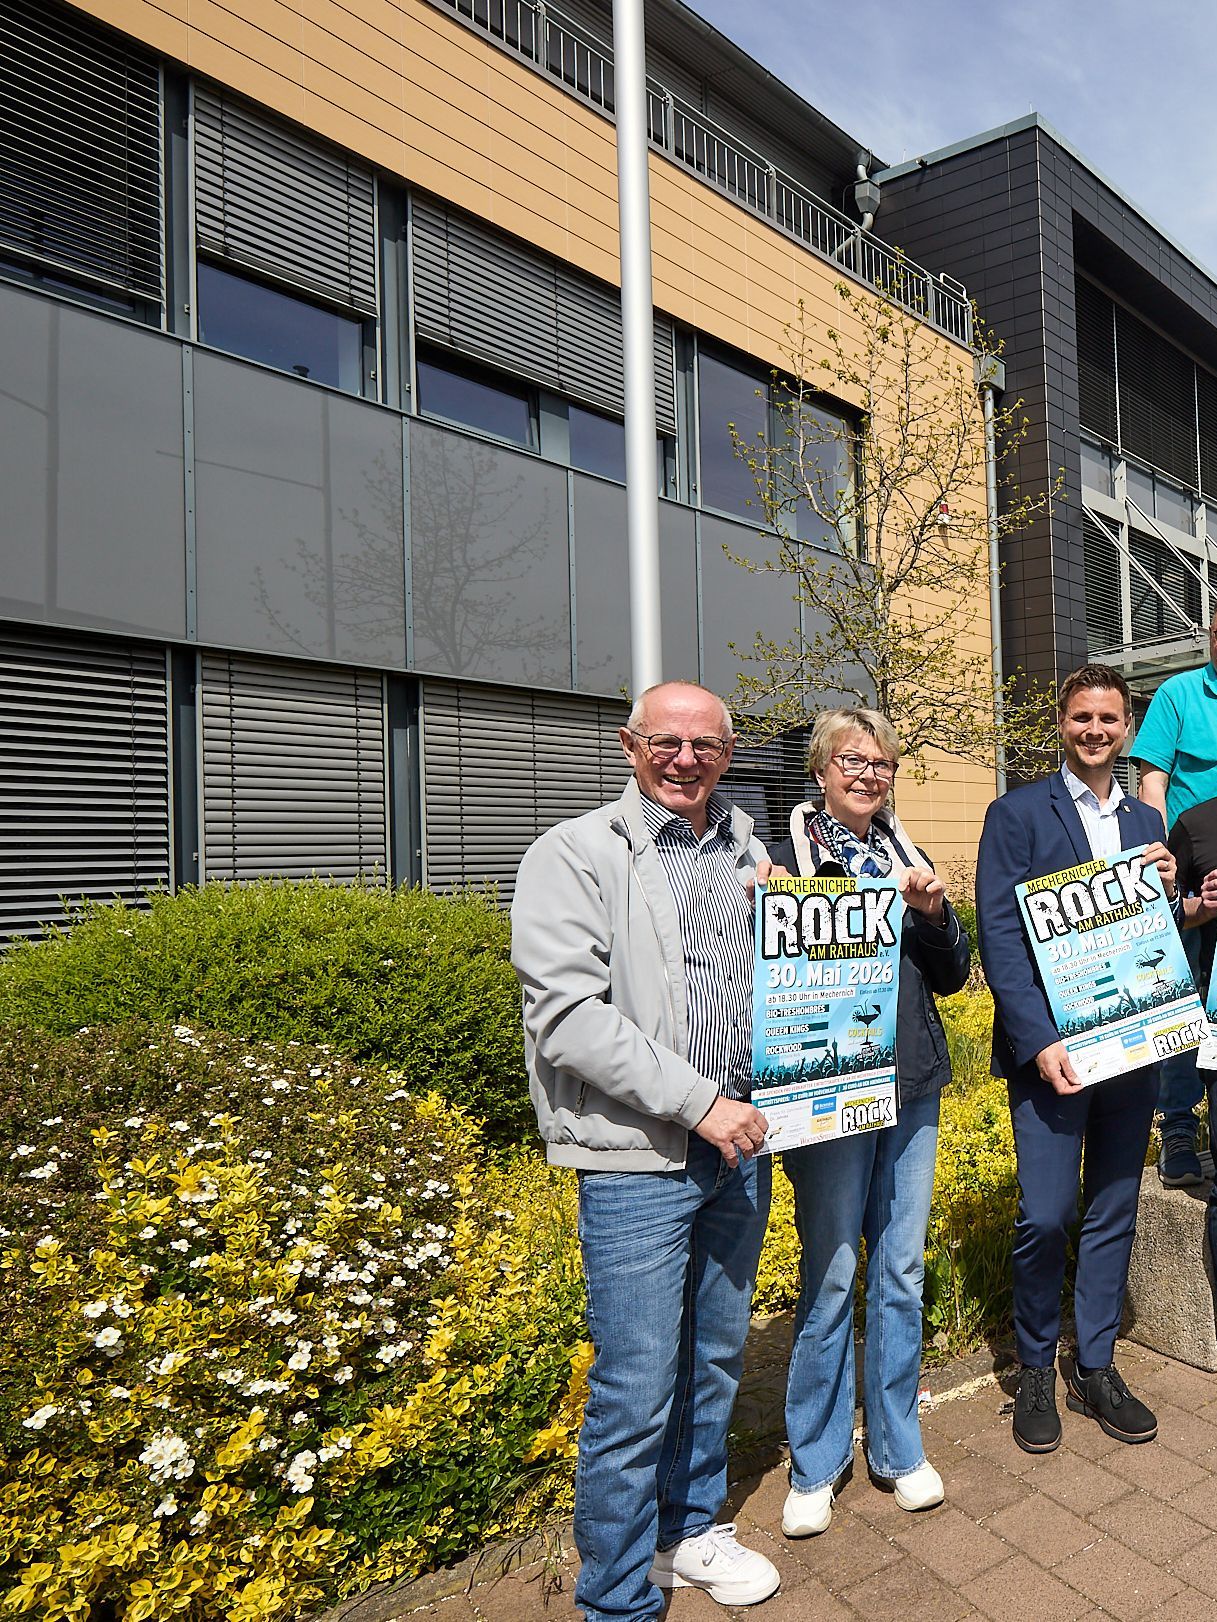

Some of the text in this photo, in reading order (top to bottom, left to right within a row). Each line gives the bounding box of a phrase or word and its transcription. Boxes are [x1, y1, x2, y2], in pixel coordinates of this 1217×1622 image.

[769, 880, 856, 893] MECHERNICHER
[1027, 861, 1106, 894] MECHERNICHER
[1024, 854, 1161, 943] ROCK
[762, 888, 896, 959] ROCK
[1078, 918, 1095, 932] AM
[1098, 902, 1144, 926] RATHAUS
[1045, 911, 1169, 962] 30. Mai 2026
[810, 946, 826, 960] AM
[831, 942, 877, 959] RATHAUS
[1099, 943, 1132, 958] Mechernich
[767, 961, 893, 988] 30. Mai 2026
[768, 995, 776, 1004] ab
[778, 994, 796, 1003] 18.30
[799, 993, 810, 1001] Uhr
[820, 988, 853, 998] Mechernich
[766, 1004, 825, 1019] BIO-TRESHOMBRES
[766, 1026, 788, 1037] QUEEN
[790, 1024, 809, 1034] KINGS
[1153, 1021, 1208, 1057] ROCK
[765, 1042, 802, 1055] ROCKWOOD
[842, 1096, 892, 1133] ROCK
